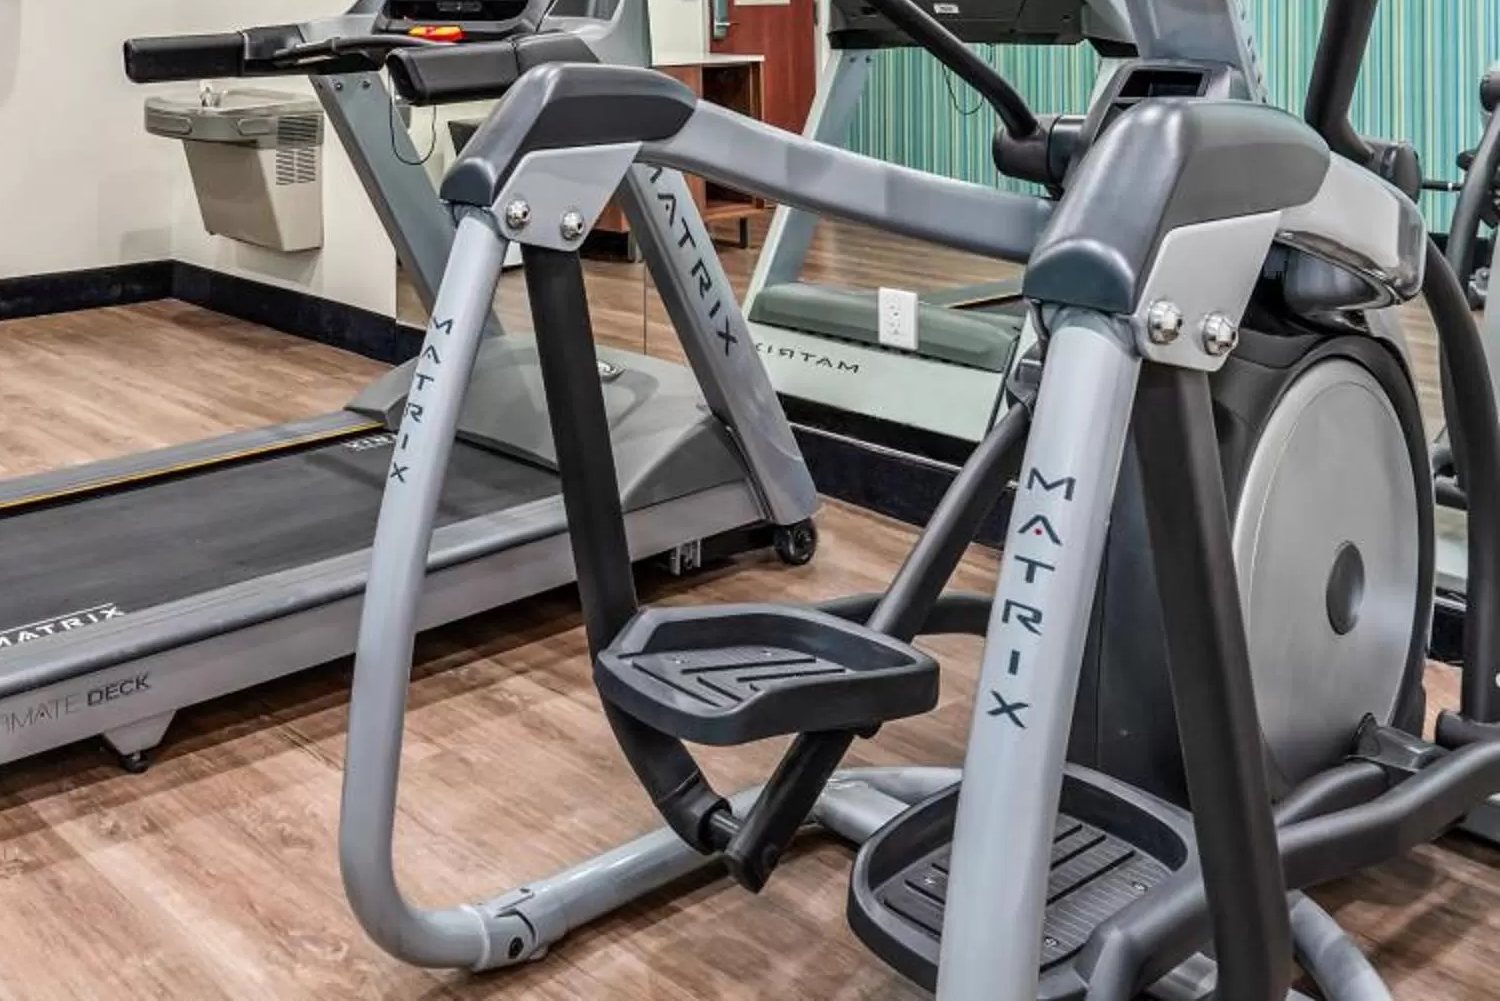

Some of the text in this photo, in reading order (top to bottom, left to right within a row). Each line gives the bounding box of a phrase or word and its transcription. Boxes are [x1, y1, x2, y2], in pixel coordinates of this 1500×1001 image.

[650, 167, 738, 357] ATRIX
[390, 317, 454, 483] MATRIX
[987, 467, 1076, 730] MATRIX
[87, 671, 151, 707] DECK
